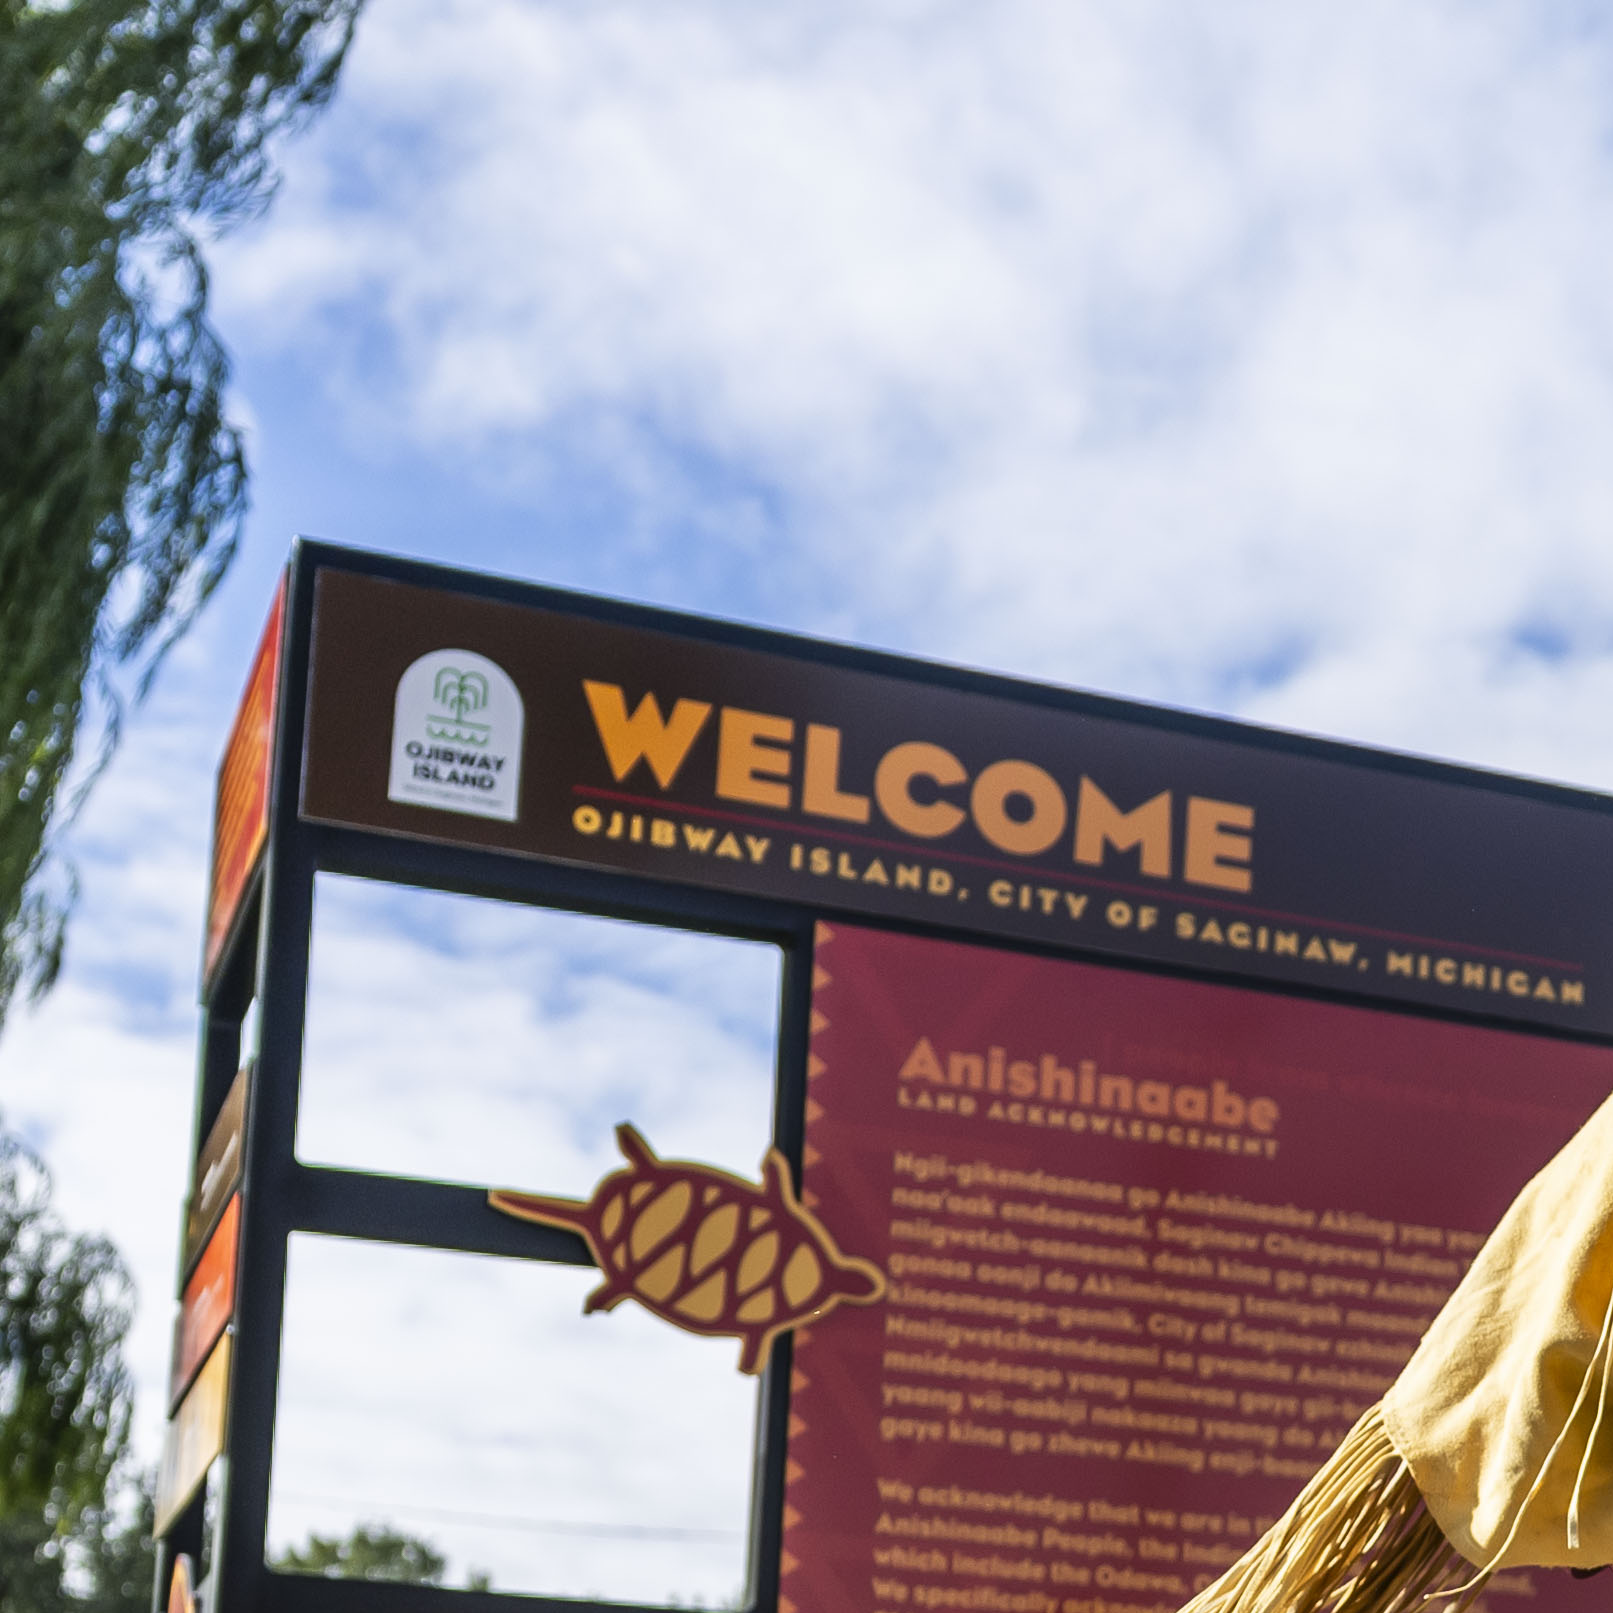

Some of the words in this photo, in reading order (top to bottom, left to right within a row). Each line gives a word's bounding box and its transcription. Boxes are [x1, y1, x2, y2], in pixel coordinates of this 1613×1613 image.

[405, 740, 506, 773] OJIBWAY
[413, 765, 496, 791] ISLAND
[582, 679, 1254, 892] WELCOME
[572, 804, 769, 863] OJIBWAY
[791, 844, 969, 899] ISLAND,
[989, 880, 1087, 918] CITY
[1107, 902, 1157, 930] OF
[1176, 914, 1369, 970] SAGINAW,
[1387, 952, 1585, 1004] MICHIGAN
[899, 1037, 1280, 1133] Anishinaabe
[898, 1086, 976, 1117] LAND
[988, 1102, 1279, 1158] ACKNOWLEDGEMENT
[1158, 1219, 1260, 1250] Saginaw
[1263, 1233, 1381, 1268] Chippewa
[1384, 1249, 1459, 1277] Indian
[1148, 1313, 1198, 1342] City
[1201, 1320, 1227, 1342] of
[1230, 1322, 1331, 1353] Saginaw
[877, 1479, 914, 1503] We
[917, 1486, 1084, 1523] acknowledge
[1088, 1500, 1139, 1524] that
[1145, 1510, 1177, 1529] we
[1180, 1513, 1224, 1534] are
[1227, 1515, 1251, 1535] in
[875, 1513, 1038, 1548] Anishinaabe
[1138, 1538, 1179, 1561] the
[872, 1578, 908, 1602] We
[874, 1545, 947, 1571] which
[952, 1553, 1046, 1580] include
[1050, 1562, 1091, 1585] the
